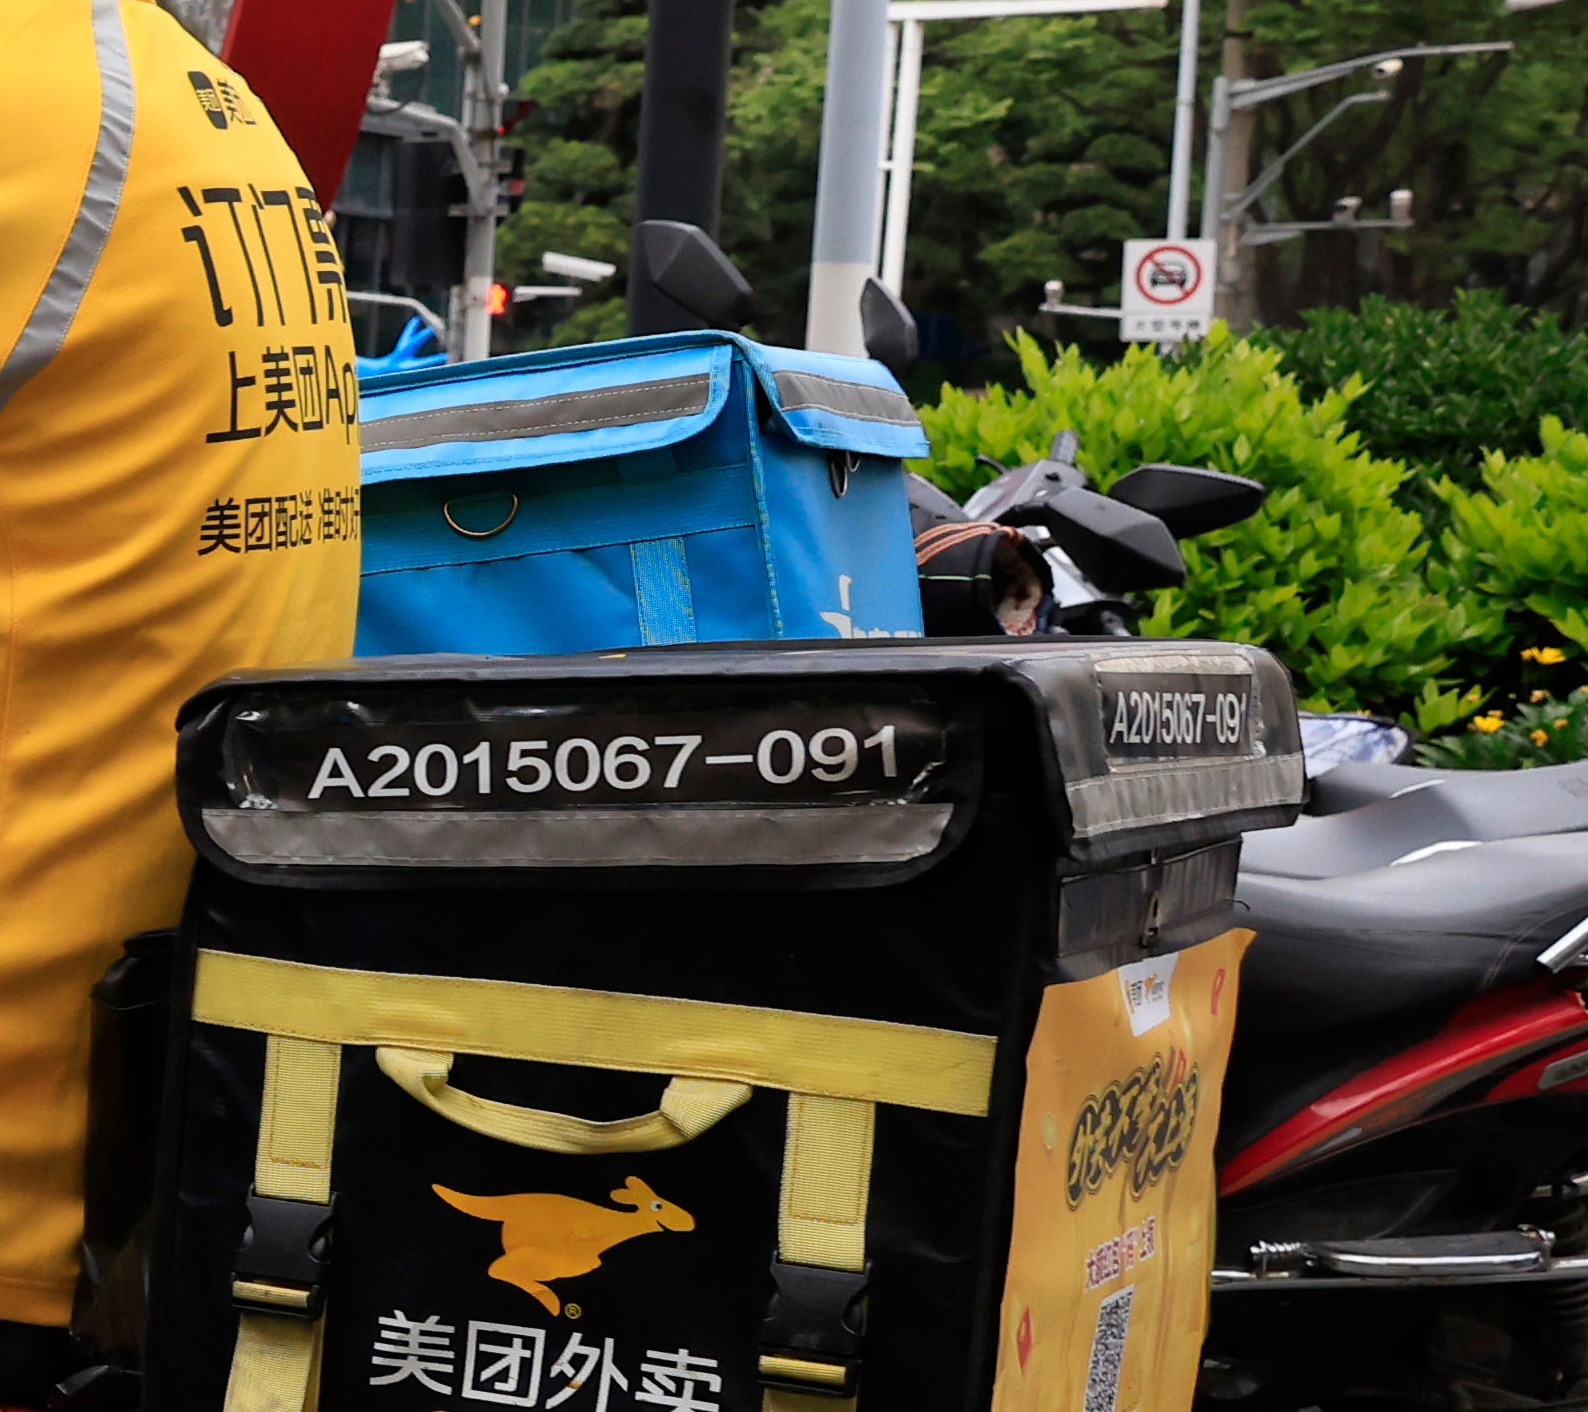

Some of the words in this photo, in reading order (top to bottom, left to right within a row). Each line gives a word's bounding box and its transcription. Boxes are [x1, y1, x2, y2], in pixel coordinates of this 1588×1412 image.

[197, 490, 314, 556] 美团配送
[1109, 691, 1247, 744] A2015067-091
[308, 724, 903, 801] A2015067-091
